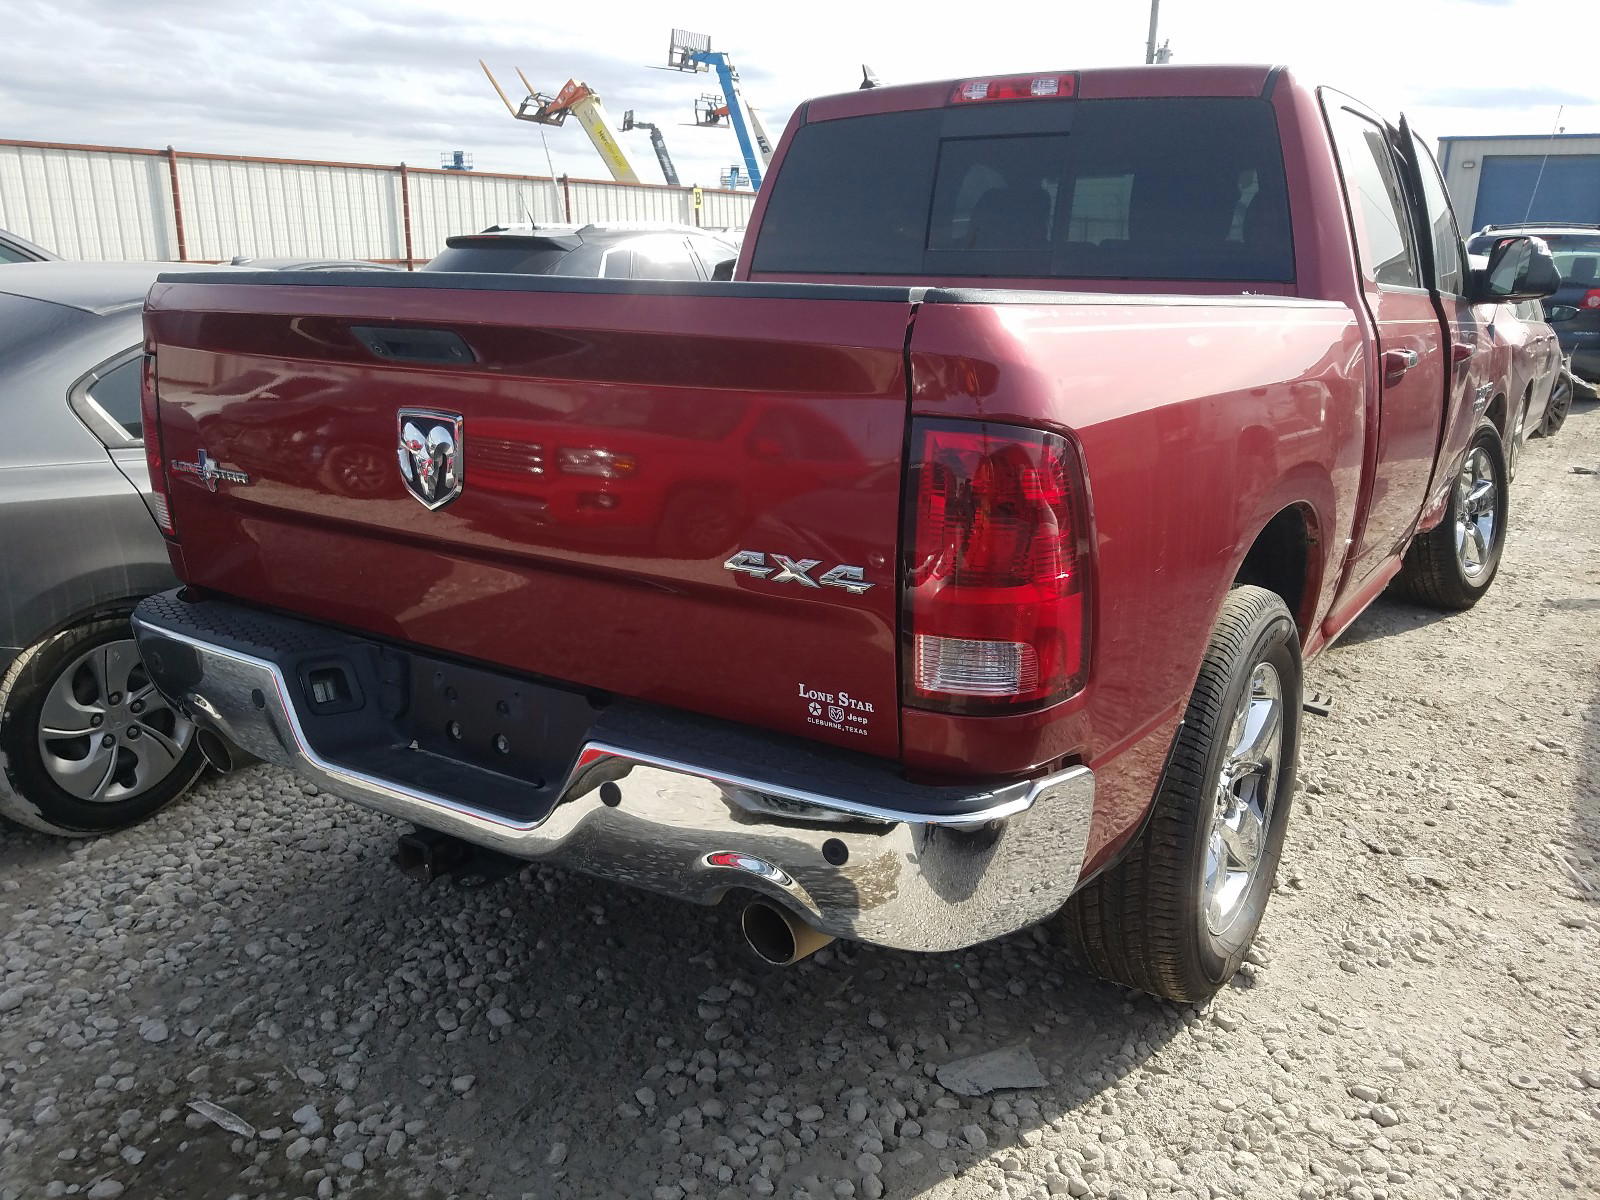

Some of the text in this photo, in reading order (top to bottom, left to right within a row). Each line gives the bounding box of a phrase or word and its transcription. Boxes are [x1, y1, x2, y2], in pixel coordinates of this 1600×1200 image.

[757, 136, 771, 154] JLG
[694, 191, 702, 206] B
[847, 713, 868, 725] Jeep
[845, 725, 868, 736] TEXAS
